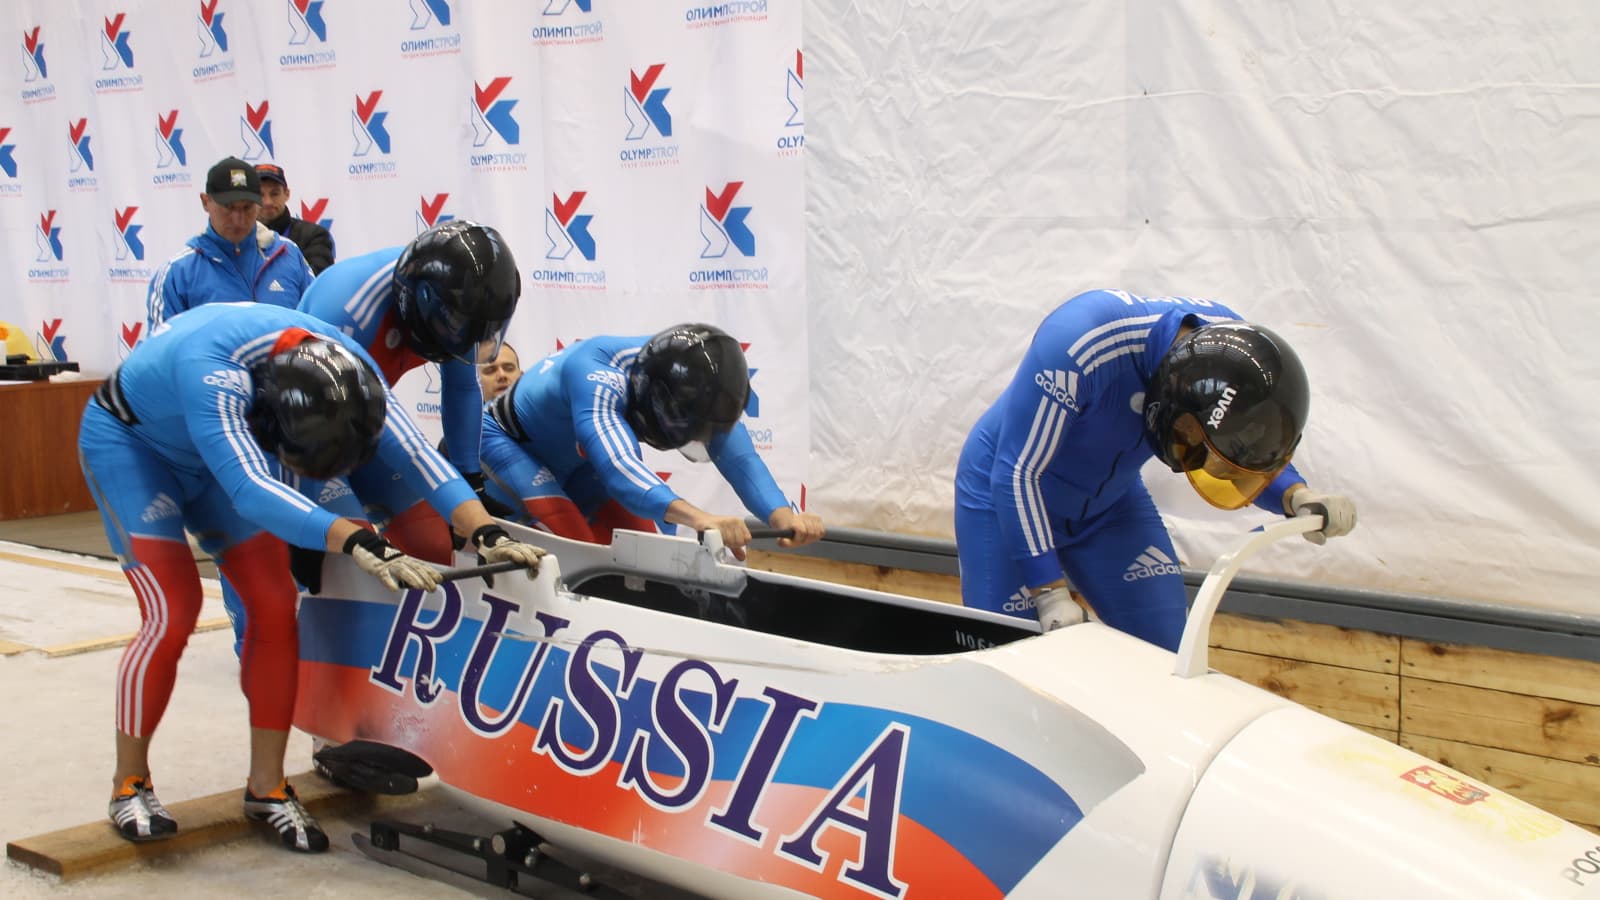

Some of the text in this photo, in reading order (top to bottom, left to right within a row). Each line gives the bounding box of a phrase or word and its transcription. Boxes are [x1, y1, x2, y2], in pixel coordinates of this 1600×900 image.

[532, 20, 603, 39] ОЛИМПСТРОЙ
[400, 33, 461, 52] ОЛИМПСТРОЙ
[620, 144, 680, 161] OLYMPSTROY
[533, 270, 606, 283] ОЛИМПСТРОЙ
[689, 267, 769, 282] ОЛИМПСТРОЙ
[1035, 372, 1080, 412] adidas
[1206, 387, 1237, 430] uvex
[1123, 563, 1181, 582] adidas
[369, 580, 908, 898] RUSSIA
